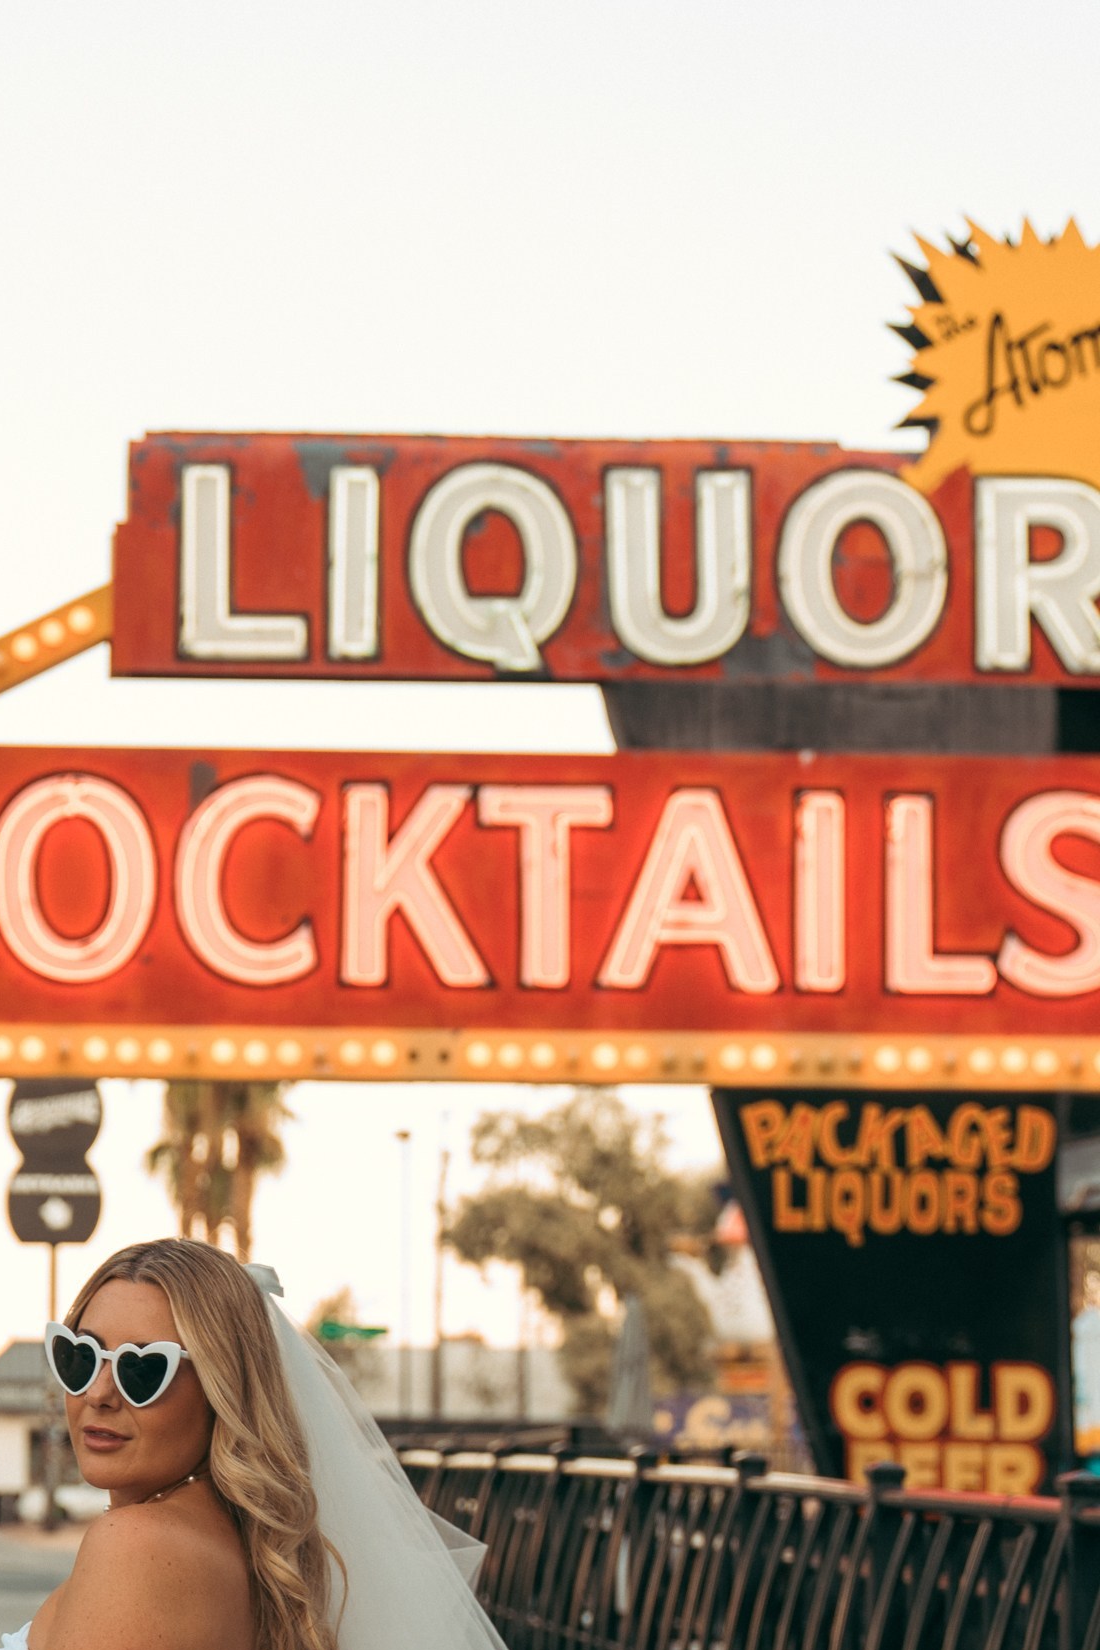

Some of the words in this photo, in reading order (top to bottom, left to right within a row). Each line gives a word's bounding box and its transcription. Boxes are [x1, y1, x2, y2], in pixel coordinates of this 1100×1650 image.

[179, 461, 1100, 673] LIQUOR
[739, 1100, 1057, 1174] PACKAGED
[772, 1167, 1022, 1246] LIQUORS
[830, 1361, 1055, 1441] COLD
